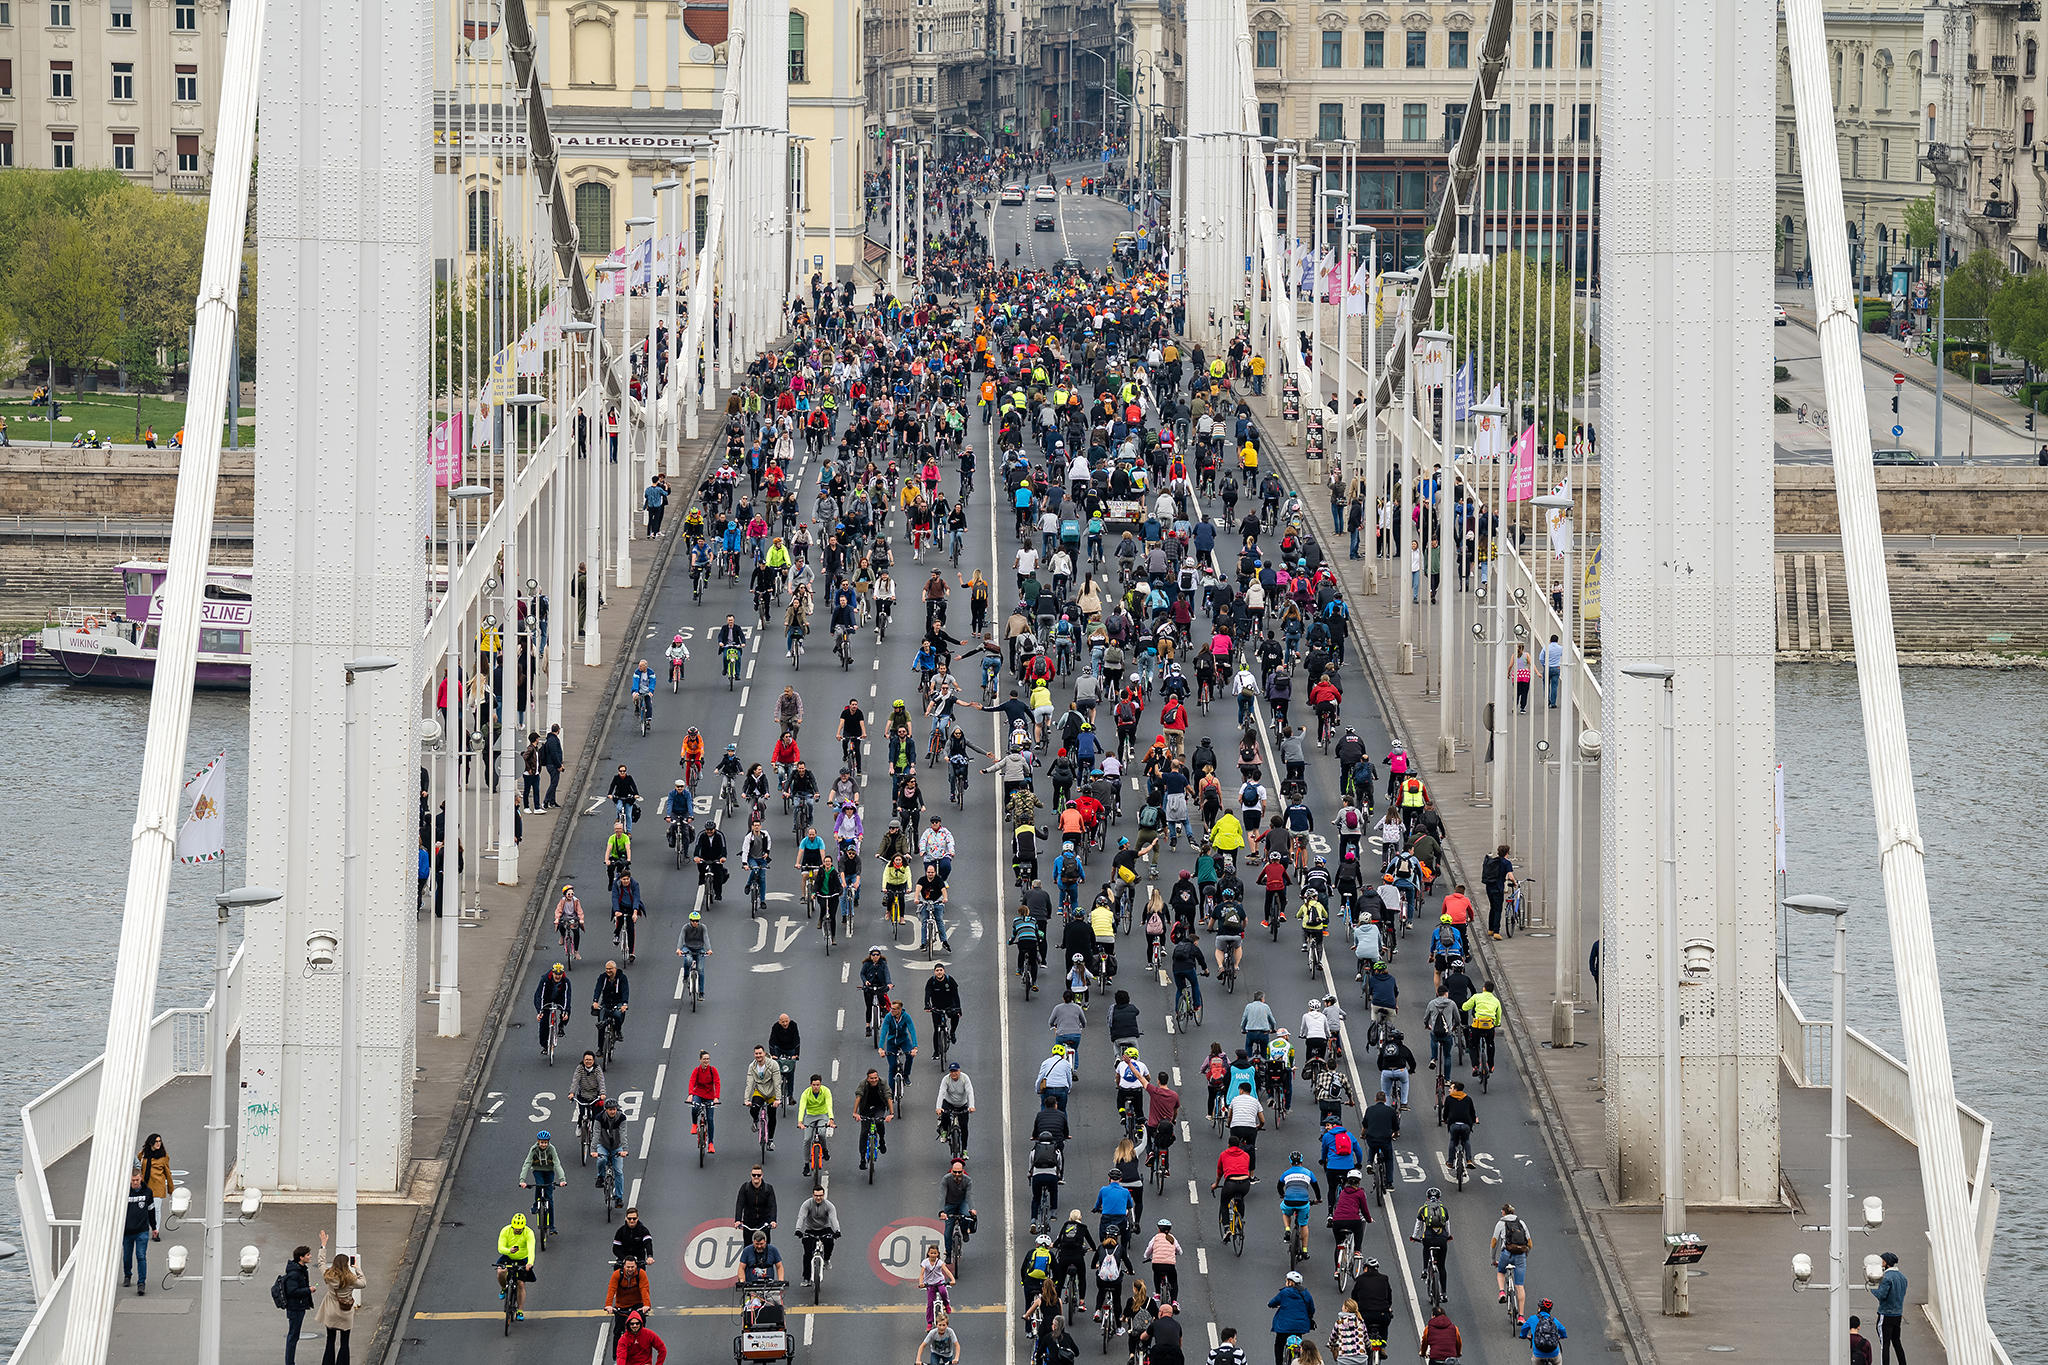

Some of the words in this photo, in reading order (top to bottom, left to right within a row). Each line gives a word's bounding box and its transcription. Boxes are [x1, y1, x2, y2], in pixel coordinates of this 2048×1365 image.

[567, 137, 580, 146] A
[585, 137, 698, 147] LELKEDDEL
[69, 637, 99, 650] WIKING
[695, 1236, 743, 1269] 40
